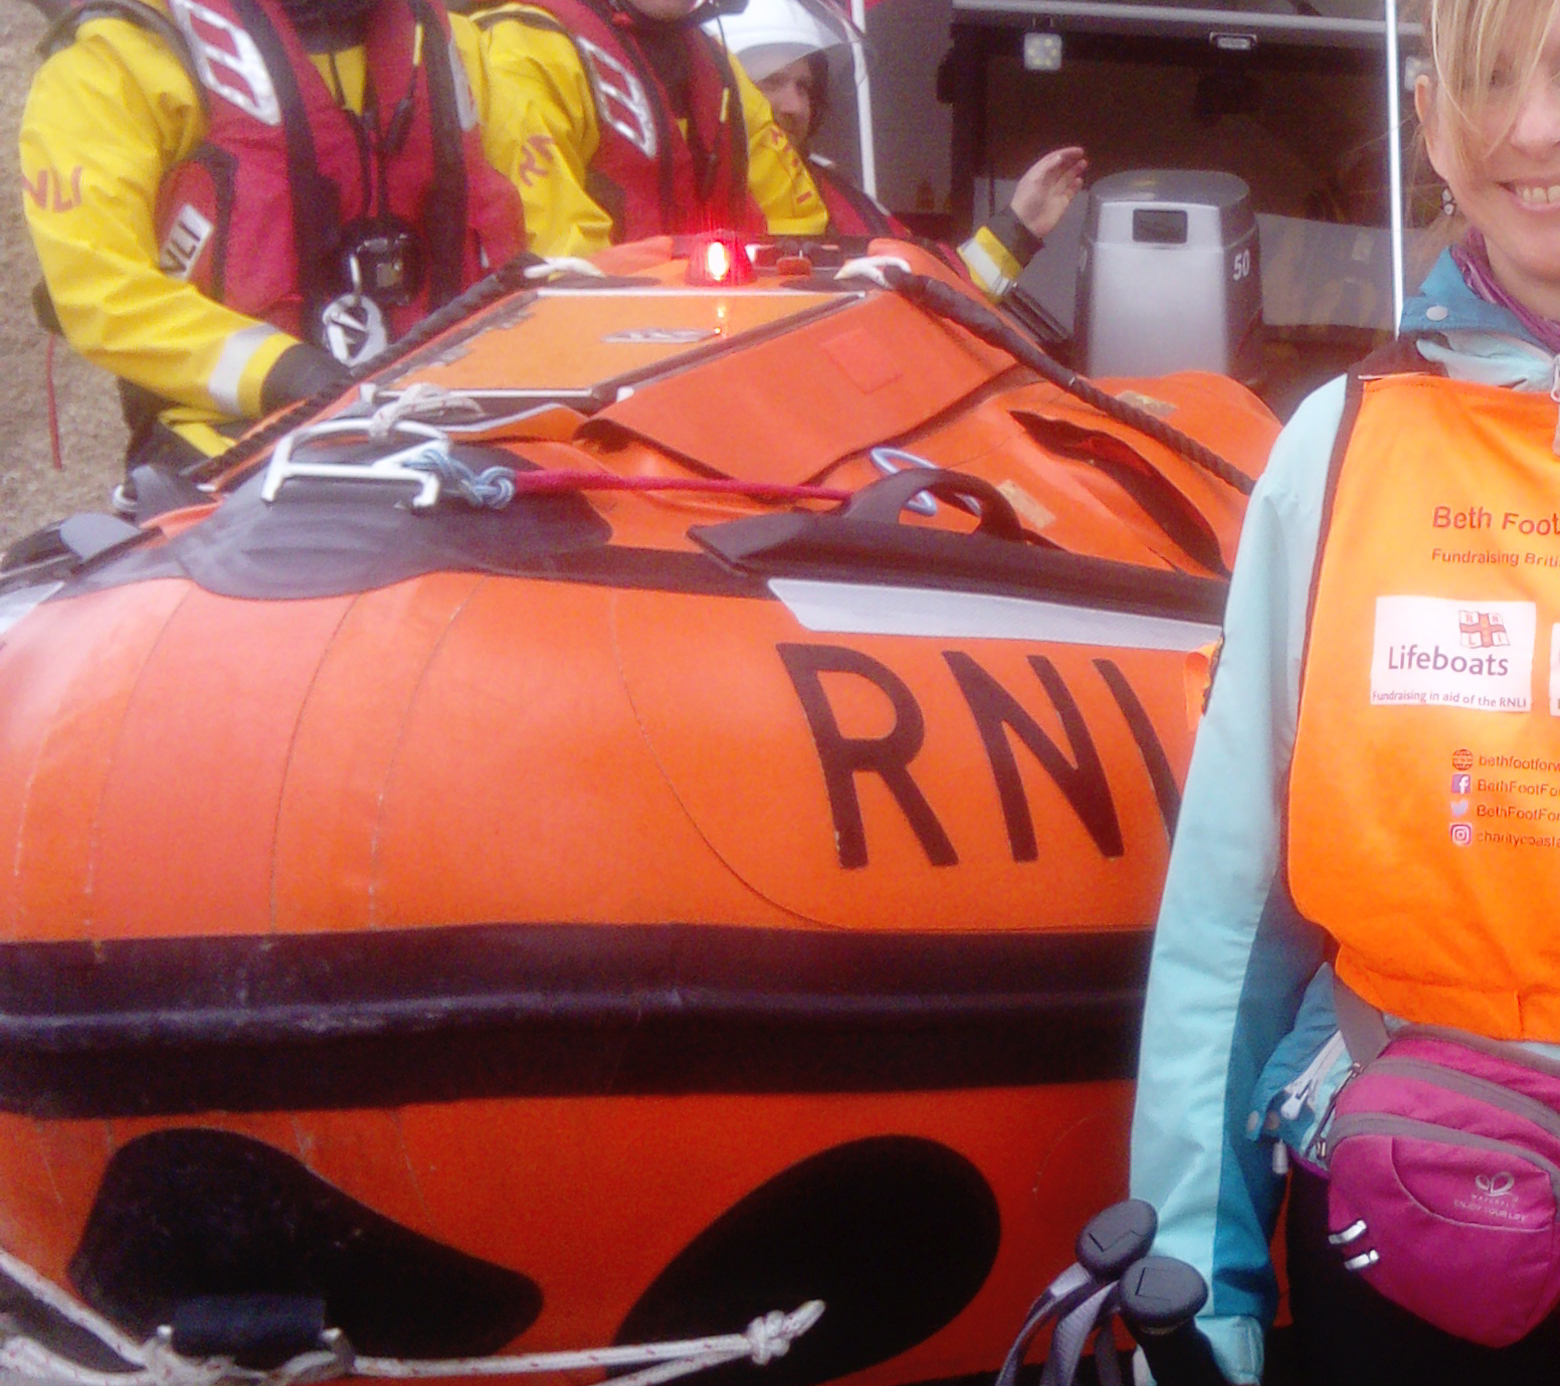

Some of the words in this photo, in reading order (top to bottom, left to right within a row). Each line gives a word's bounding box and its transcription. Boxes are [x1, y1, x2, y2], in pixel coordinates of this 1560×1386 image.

[1232, 249, 1251, 281] 50
[1432, 505, 1493, 530] Beth
[1431, 547, 1521, 568] Fundraising
[1388, 643, 1510, 677] Lifeboats
[1372, 690, 1427, 703] Fundraising
[1429, 690, 1440, 701] in
[1442, 692, 1461, 703] aid
[1462, 693, 1476, 704] of
[1478, 696, 1497, 707] the
[1499, 697, 1527, 708] RNLI
